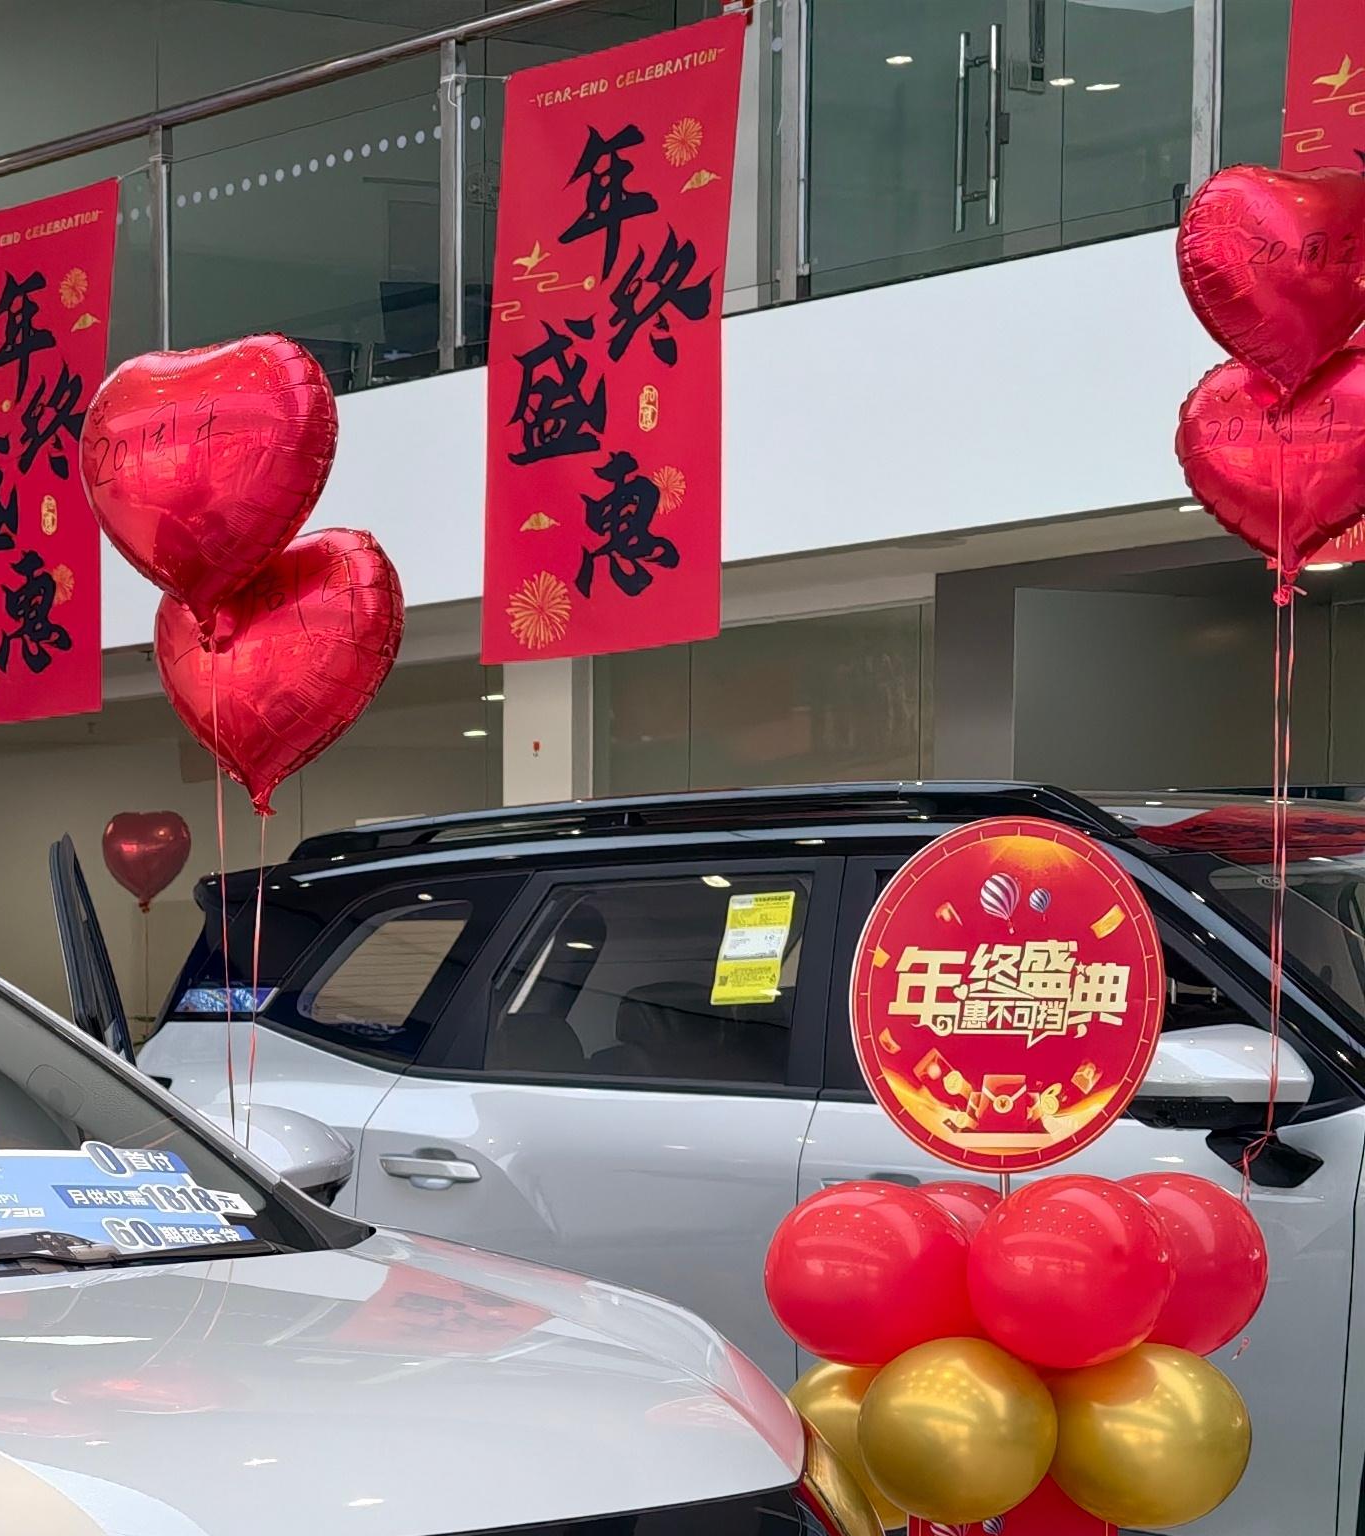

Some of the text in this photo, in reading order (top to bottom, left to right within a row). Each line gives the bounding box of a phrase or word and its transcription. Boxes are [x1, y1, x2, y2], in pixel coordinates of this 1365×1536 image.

[507, 123, 719, 599] 年终盛惠
[93, 393, 233, 487] 20周年
[888, 939, 1130, 1038] 年终盛典
[959, 1001, 1067, 1031] 惠不可挡
[84, 1142, 175, 1175] 0首付
[67, 1184, 239, 1213] 月供仅需1818元
